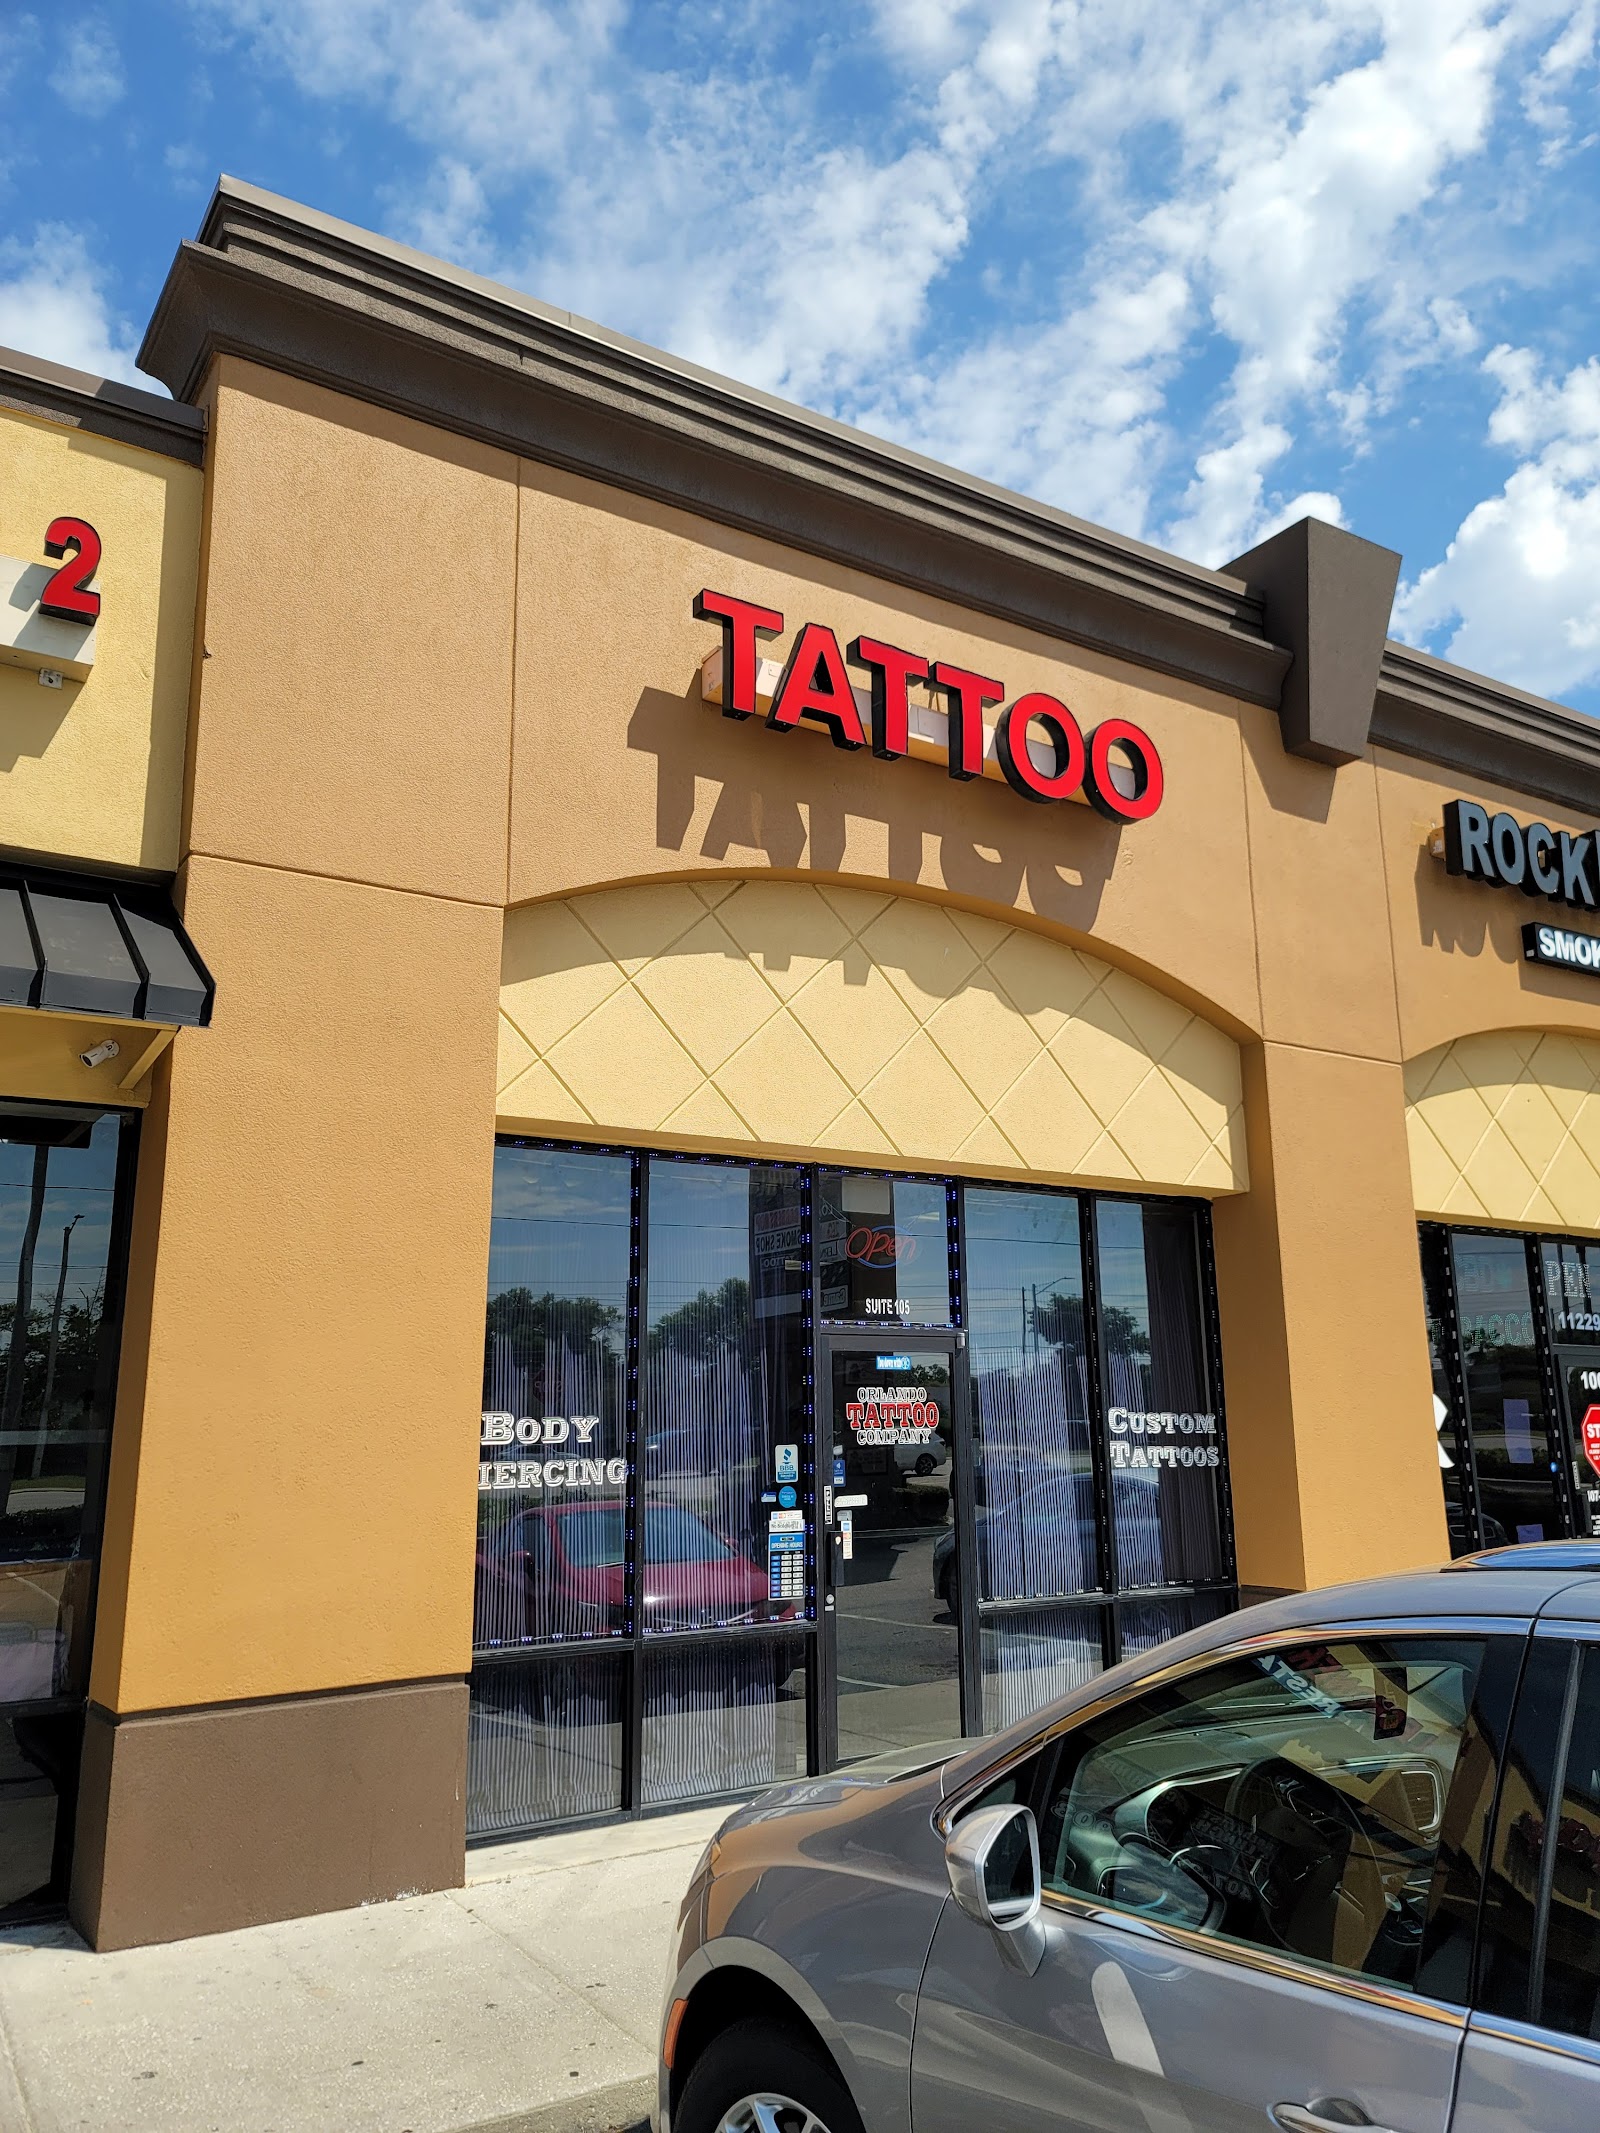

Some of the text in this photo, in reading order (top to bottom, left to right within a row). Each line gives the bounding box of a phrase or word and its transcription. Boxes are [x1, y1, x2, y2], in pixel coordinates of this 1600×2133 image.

[39, 516, 101, 625] 2
[693, 589, 1164, 824] TATTOO
[1448, 799, 1600, 909] ROCK
[865, 1298, 910, 1315] SUITE 105
[1558, 1311, 1600, 1331] 11229
[857, 1387, 927, 1403] ORLANDO
[846, 1402, 939, 1430] TATTOO
[857, 1429, 931, 1446] COMPANY
[478, 1457, 628, 1490] IERCING
